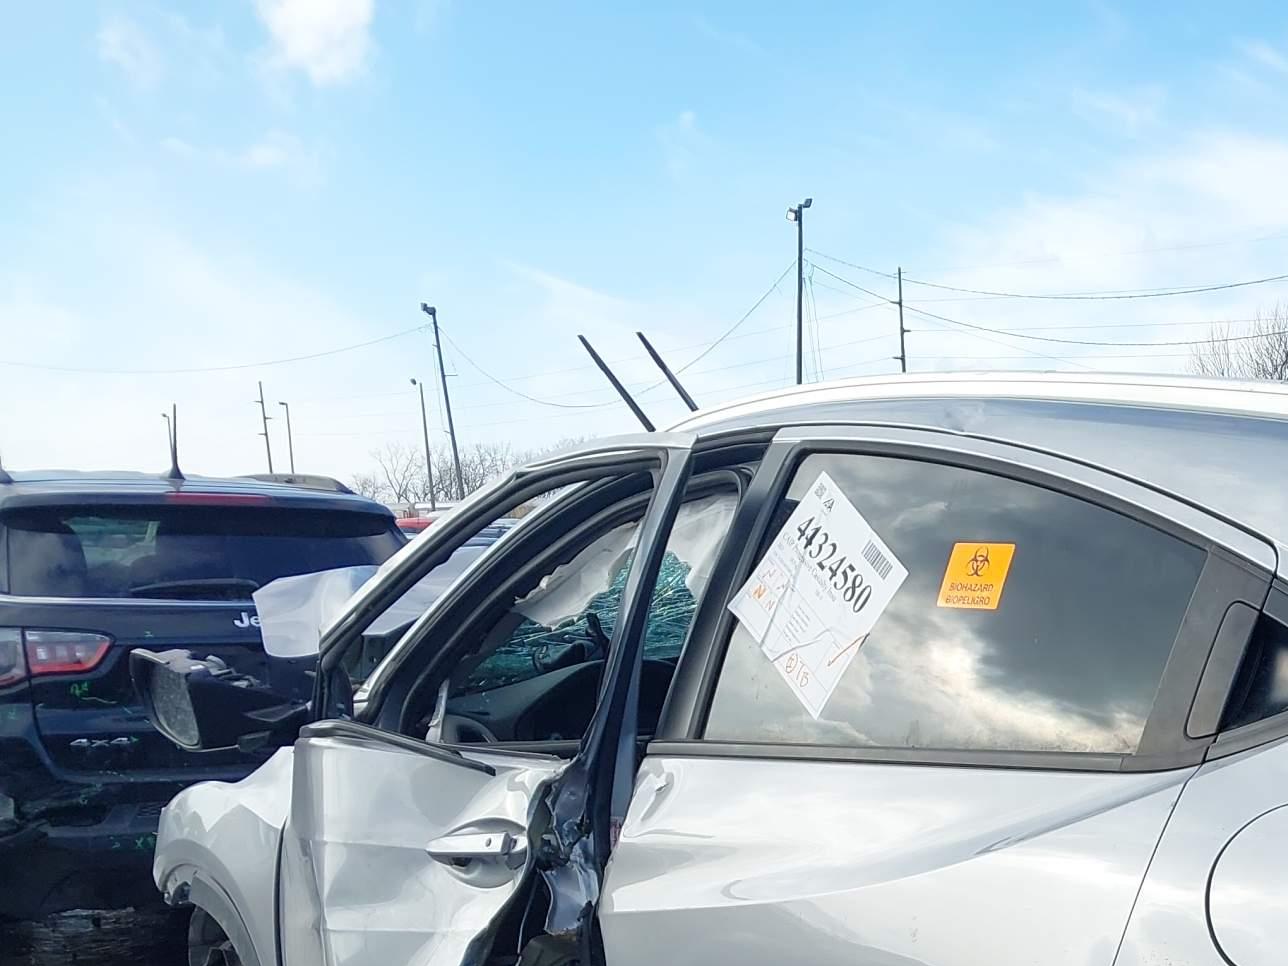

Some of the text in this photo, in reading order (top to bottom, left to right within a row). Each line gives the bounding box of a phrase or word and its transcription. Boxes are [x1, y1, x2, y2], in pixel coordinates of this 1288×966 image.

[797, 516, 872, 614] 44324580
[949, 582, 994, 592] BIOHAZARD
[946, 595, 991, 605] BIOPELIGRO
